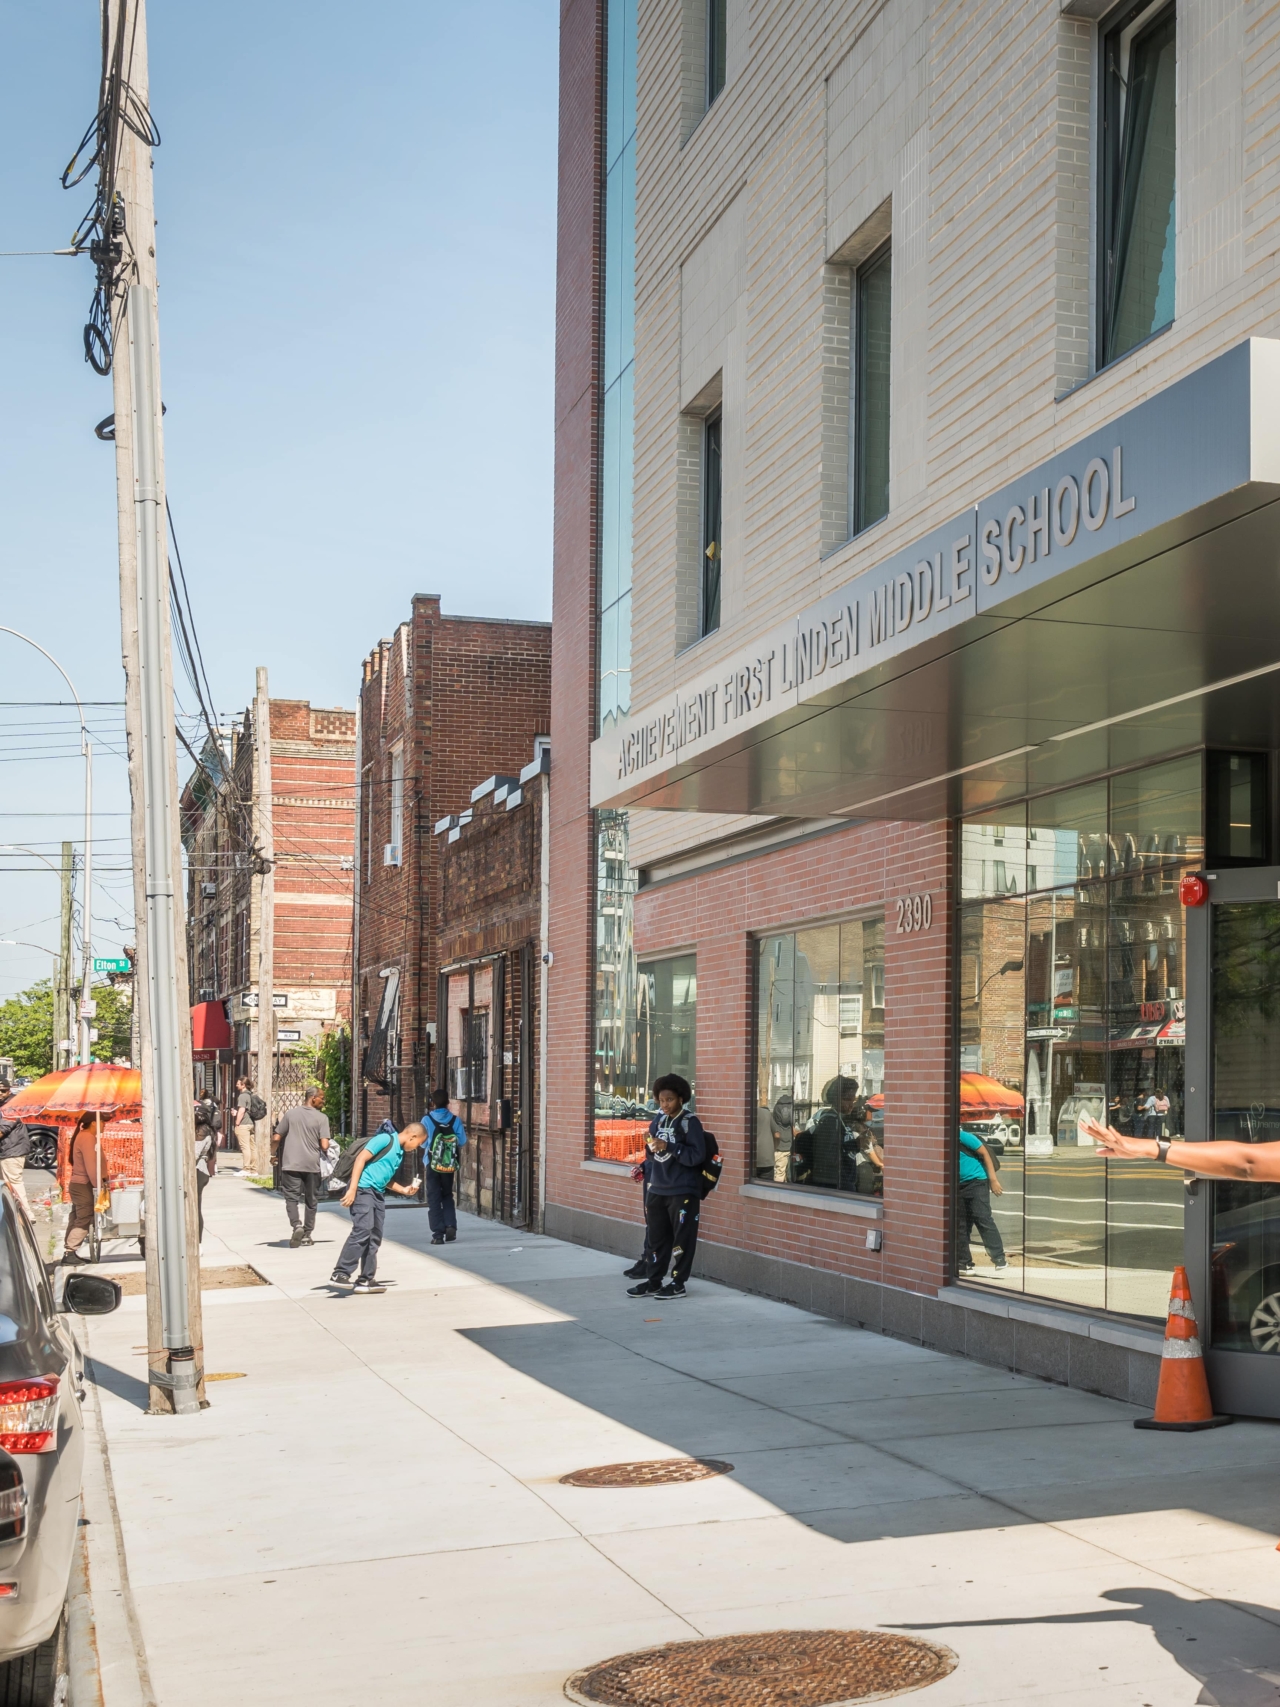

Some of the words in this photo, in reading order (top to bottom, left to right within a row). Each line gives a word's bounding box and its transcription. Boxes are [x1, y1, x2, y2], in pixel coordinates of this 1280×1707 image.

[617, 683, 718, 780] ACHIEVEMENT
[722, 650, 775, 724] FIRST
[781, 600, 860, 694] LINDEN
[868, 534, 970, 648] MIDDLE
[981, 445, 1136, 586] SCHOOL
[1183, 876, 1196, 884] STOP
[896, 894, 932, 934] 2390
[96, 960, 117, 970] Elton
